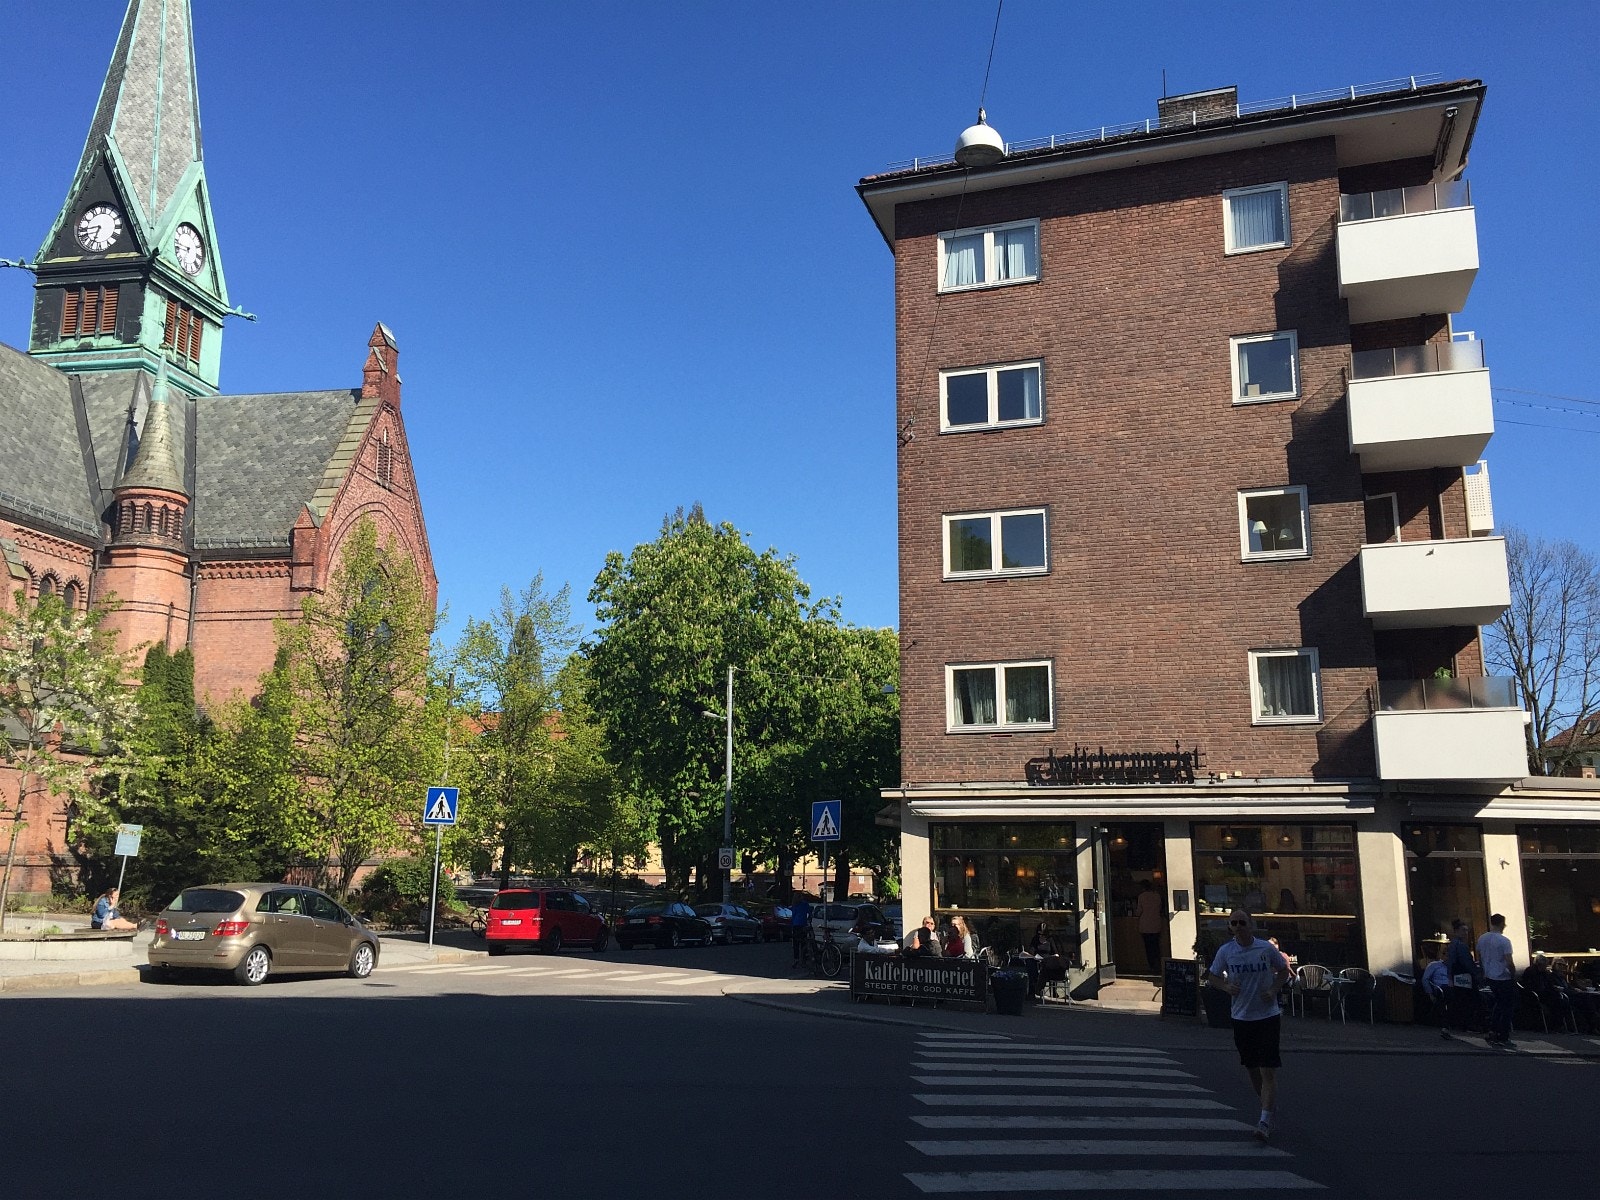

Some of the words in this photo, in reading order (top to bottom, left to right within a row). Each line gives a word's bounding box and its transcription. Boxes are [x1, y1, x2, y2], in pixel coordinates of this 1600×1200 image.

[865, 961, 976, 987] Kaffebrenneriet
[1230, 963, 1268, 973] ITALIA
[865, 981, 897, 991] STEDET
[923, 985, 941, 993] GOD
[946, 987, 976, 996] KAFFE
